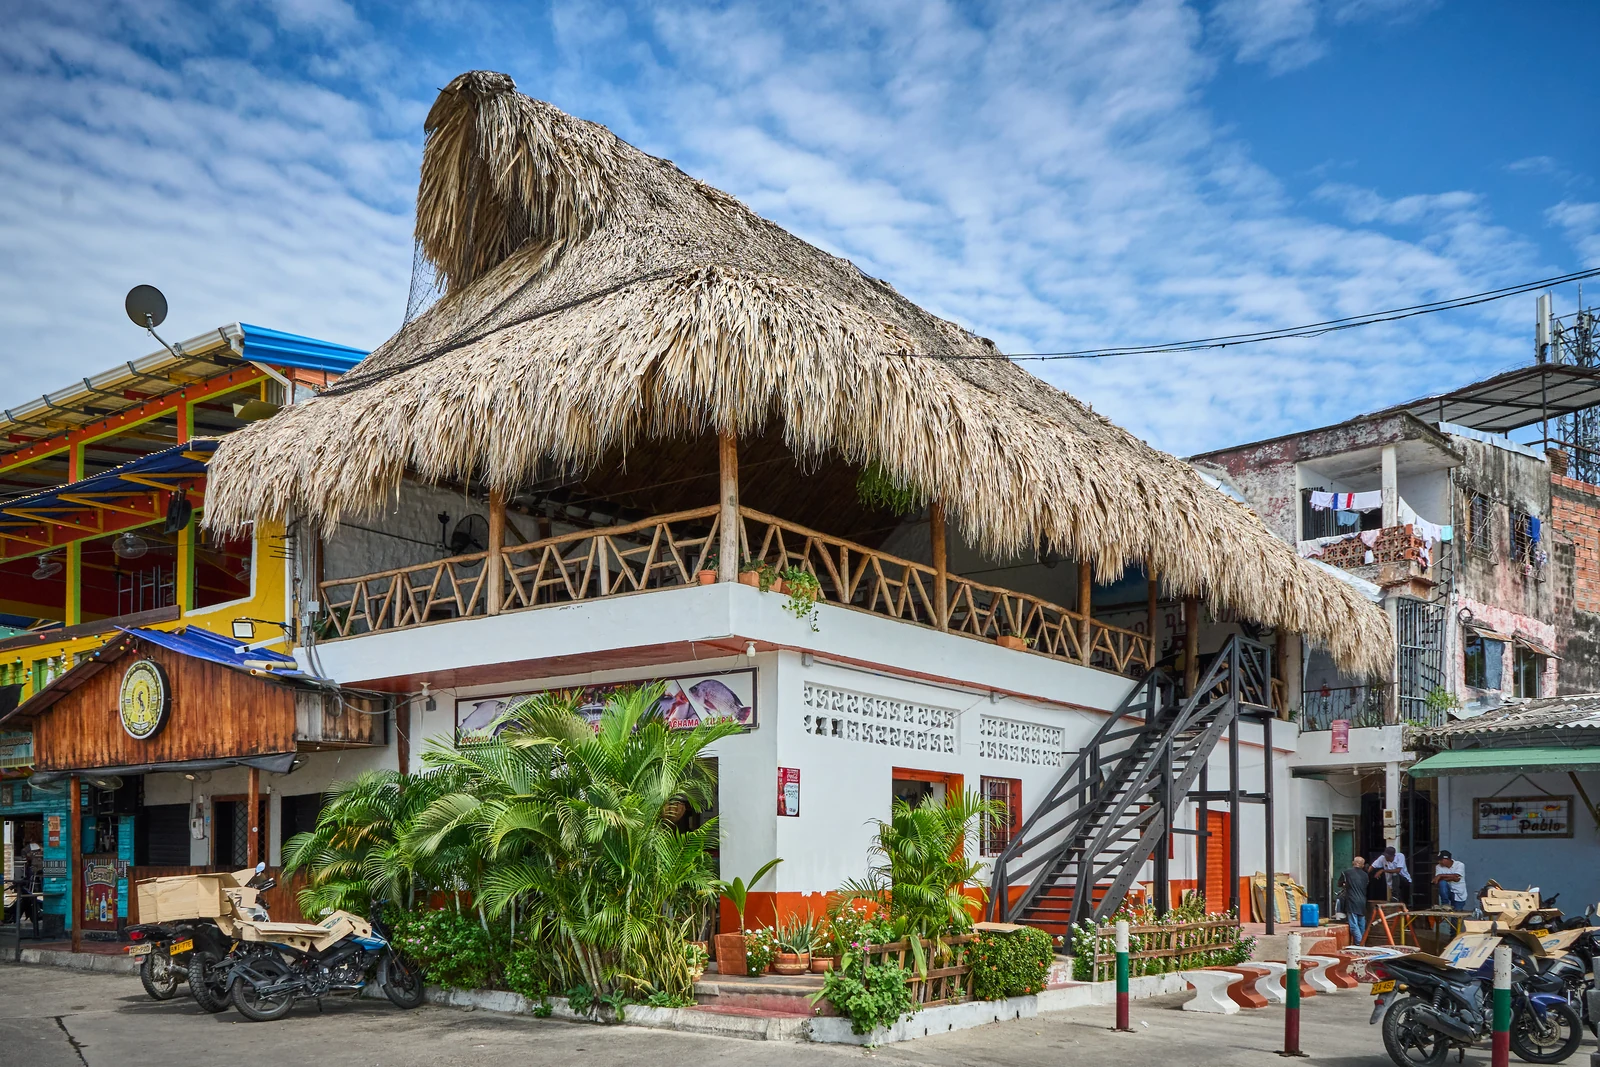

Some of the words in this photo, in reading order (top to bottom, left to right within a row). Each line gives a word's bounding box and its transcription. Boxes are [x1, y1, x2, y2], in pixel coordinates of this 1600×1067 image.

[667, 718, 699, 729] ACHAMA
[1480, 802, 1522, 818] Donde
[1519, 819, 1561, 834] Pablo
